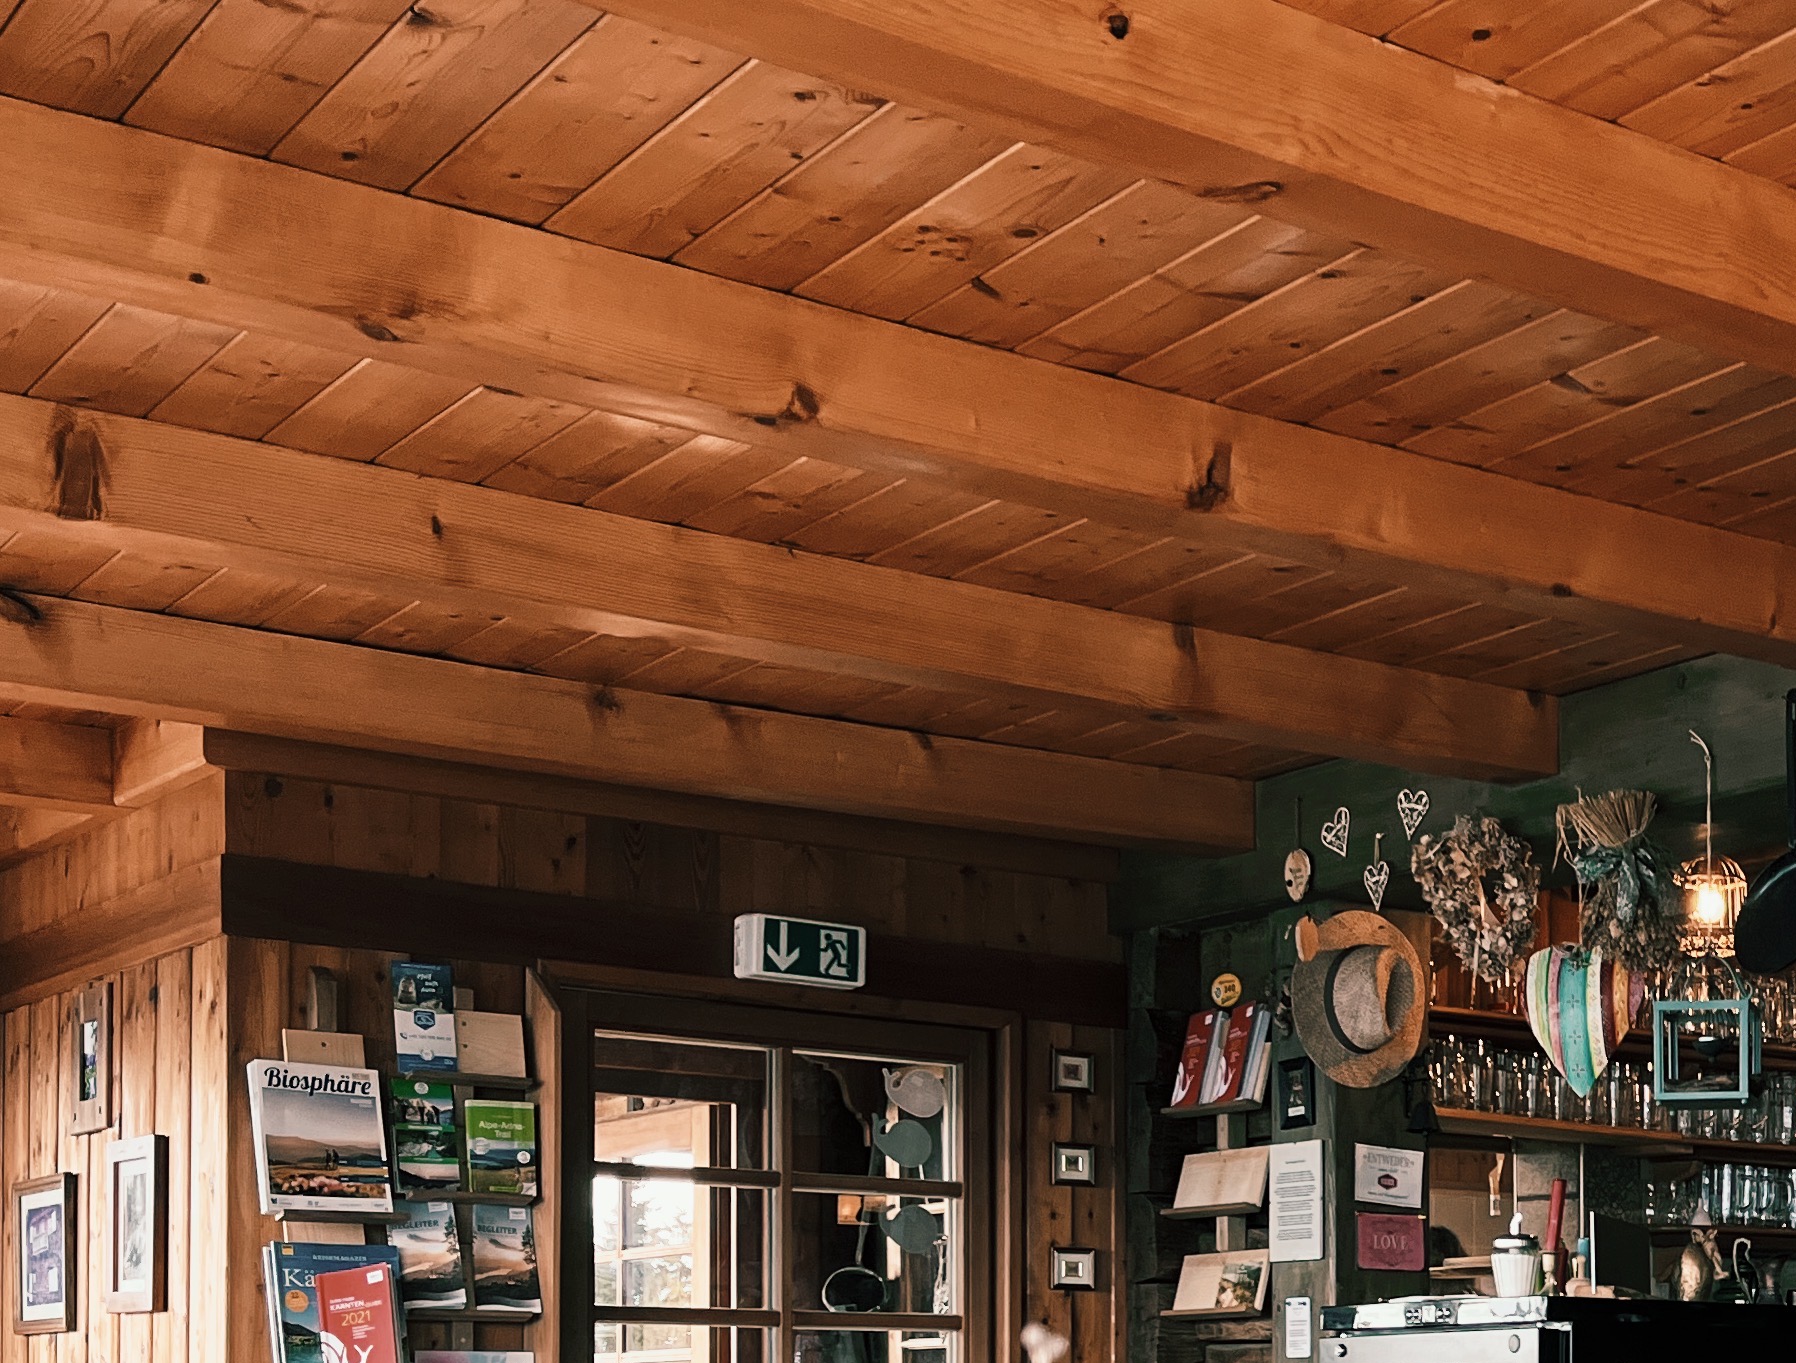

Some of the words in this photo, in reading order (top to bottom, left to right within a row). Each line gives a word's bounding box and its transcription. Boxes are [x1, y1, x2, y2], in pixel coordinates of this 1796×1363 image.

[264, 1066, 372, 1097] Biosphäre
[1373, 1234, 1408, 1250] LOVE
[282, 1268, 316, 1288] Kä
[341, 1310, 371, 1327] 2021
